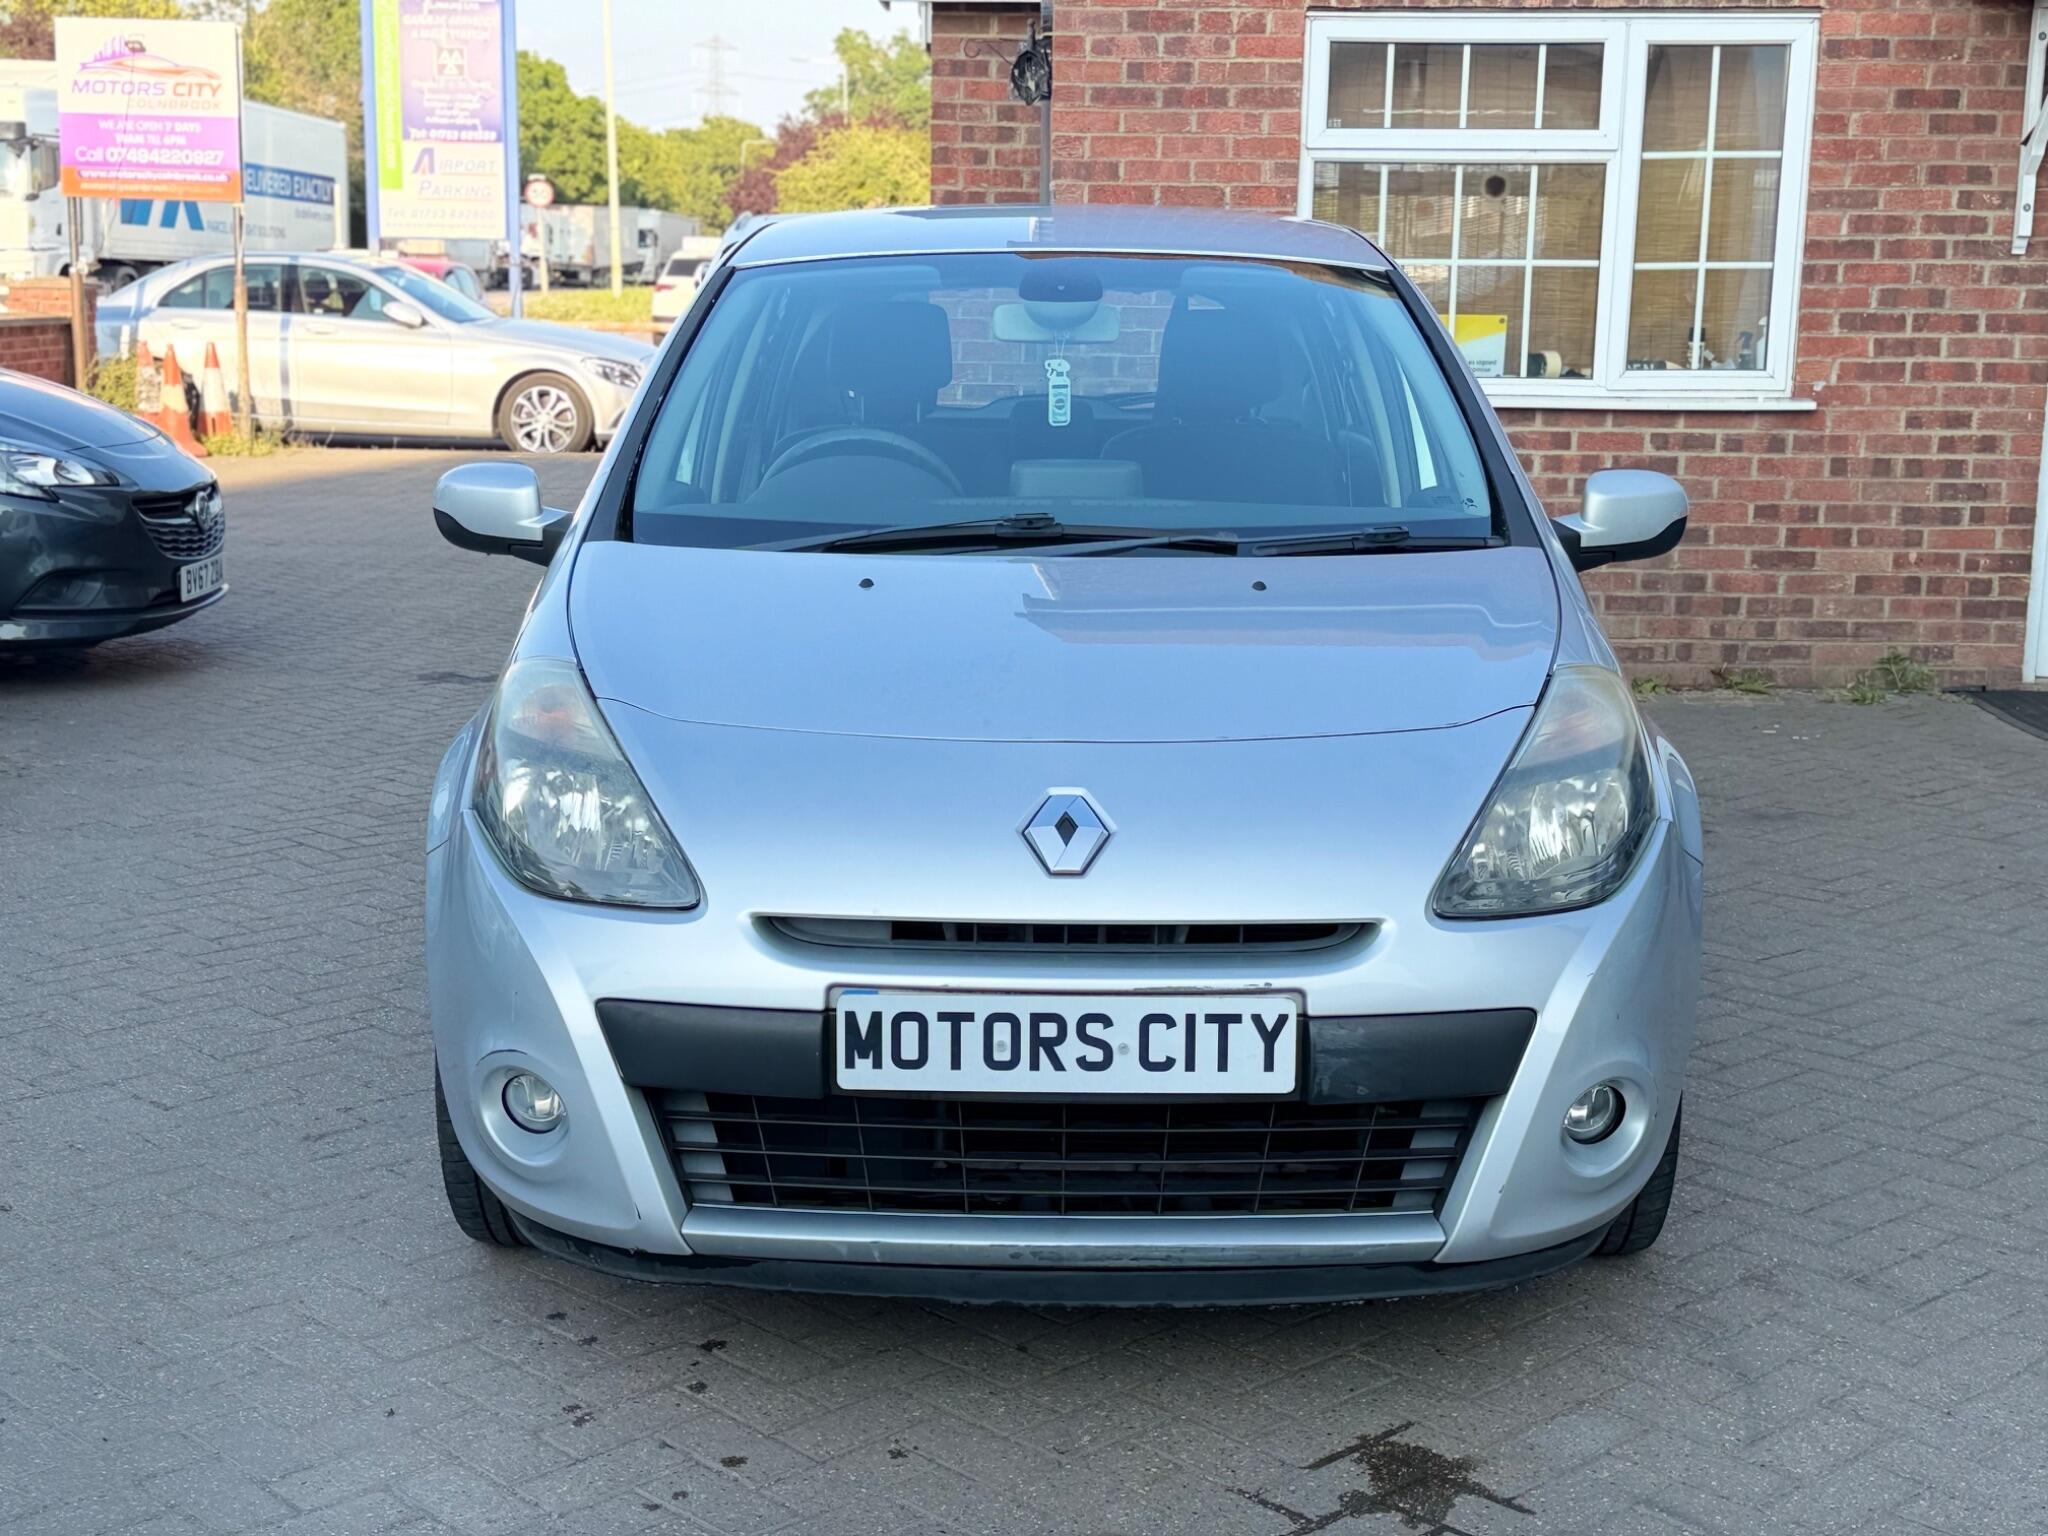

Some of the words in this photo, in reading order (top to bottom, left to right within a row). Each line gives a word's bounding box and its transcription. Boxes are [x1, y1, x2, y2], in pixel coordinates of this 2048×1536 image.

[71, 79, 165, 96] MOTORS
[172, 82, 222, 97] CITY
[127, 98, 222, 111] COLNBROOK
[136, 121, 163, 132] OPEN
[75, 147, 104, 162] Call
[412, 147, 497, 175] AIRPORT
[246, 168, 291, 195] ELIVERED
[418, 179, 492, 198] PARKING
[186, 563, 208, 594] BV67
[844, 1010, 1114, 1072] MOTORS
[1138, 1013, 1290, 1073] CITY
